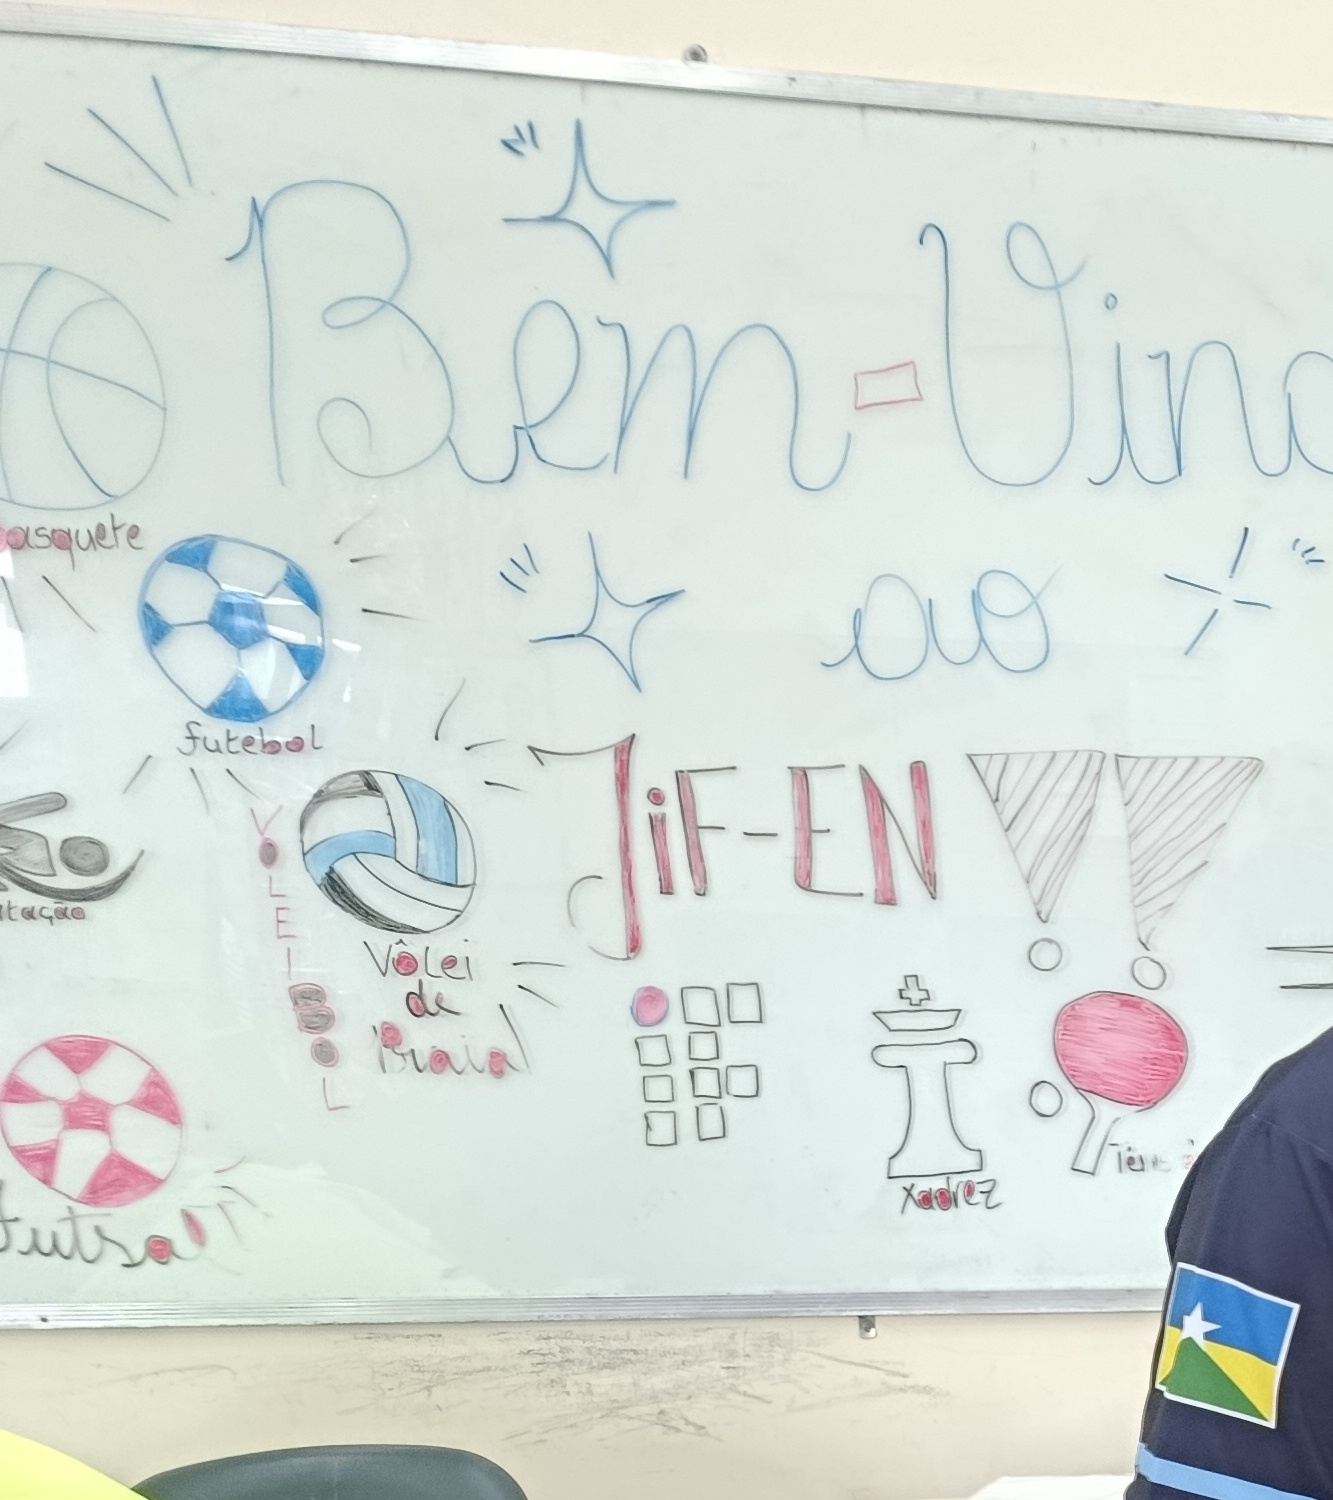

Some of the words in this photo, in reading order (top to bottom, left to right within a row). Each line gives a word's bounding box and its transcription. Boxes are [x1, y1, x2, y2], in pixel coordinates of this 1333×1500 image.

[820, 563, 1064, 680] ao
[176, 721, 324, 756] futebol
[0, 900, 86, 926] tação
